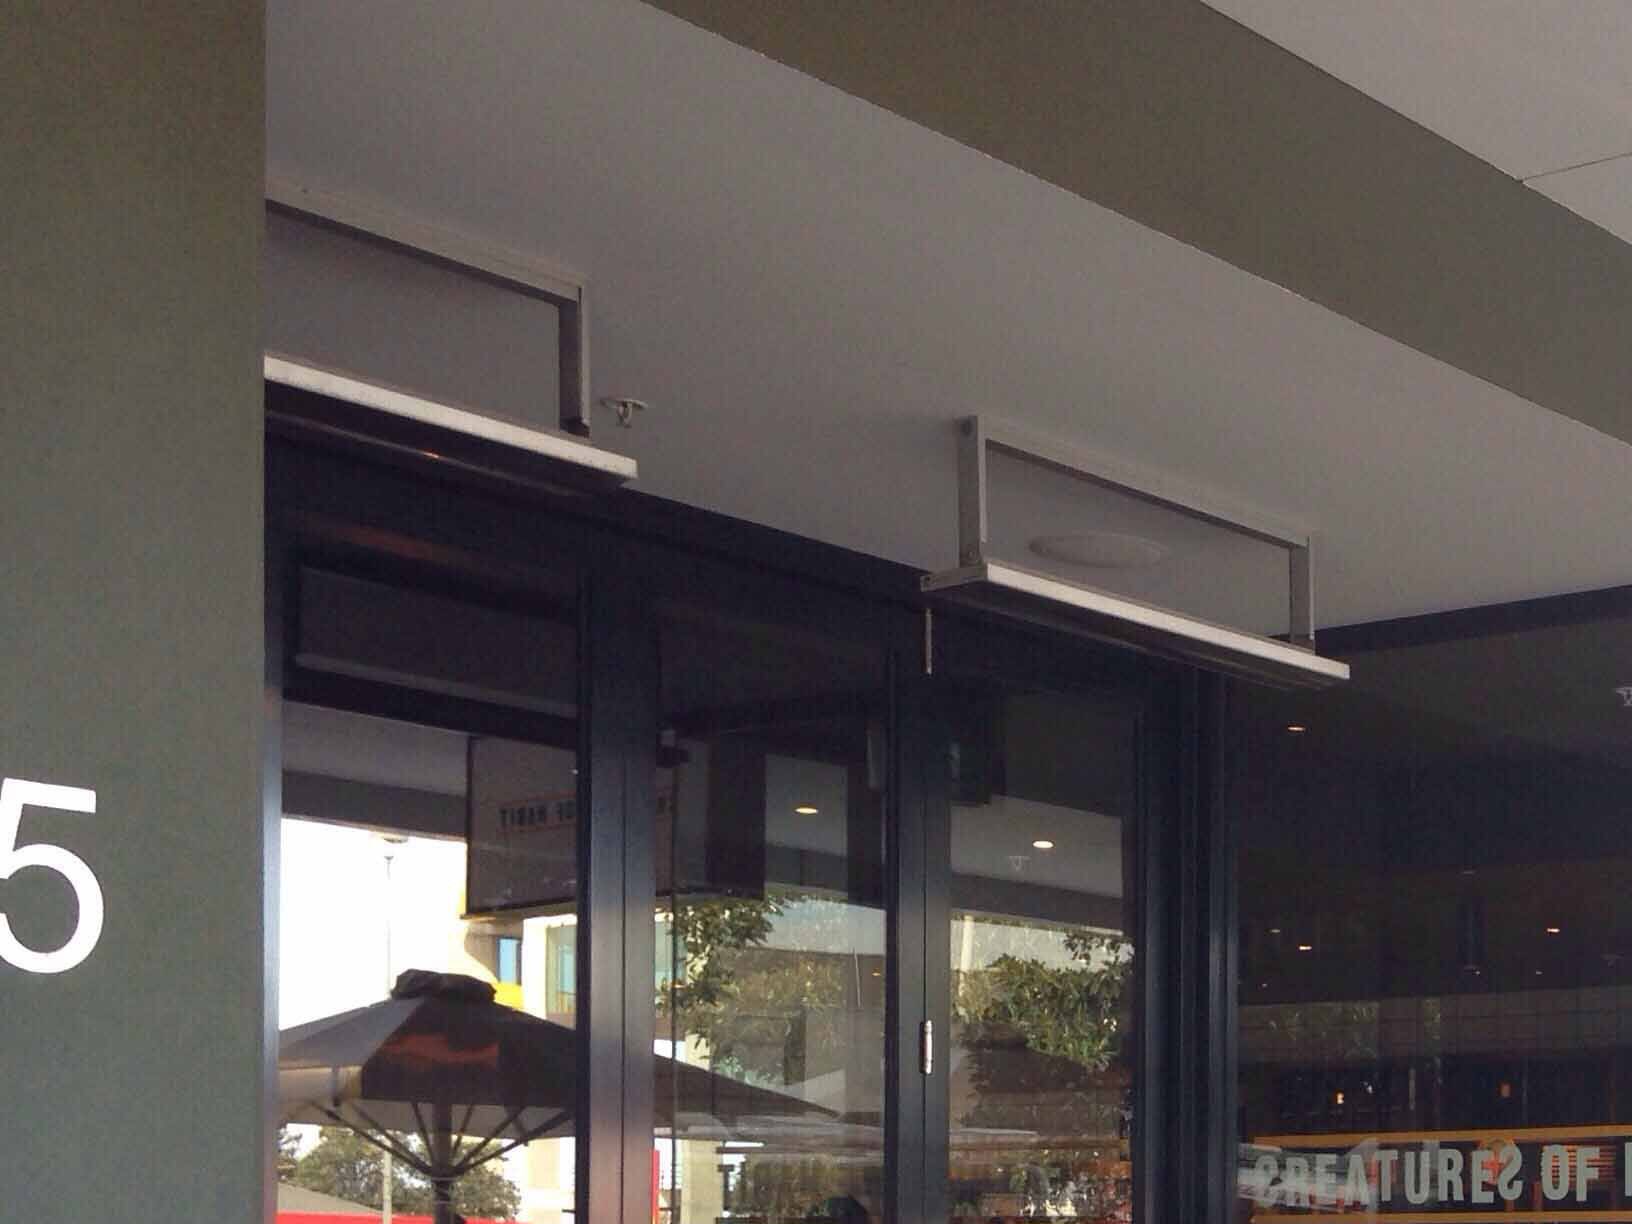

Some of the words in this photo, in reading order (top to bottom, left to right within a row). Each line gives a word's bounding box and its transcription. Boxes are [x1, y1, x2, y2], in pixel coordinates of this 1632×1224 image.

[0, 777, 104, 974] 5
[1254, 1142, 1524, 1207] CREATURES
[1540, 1144, 1601, 1201] OF
